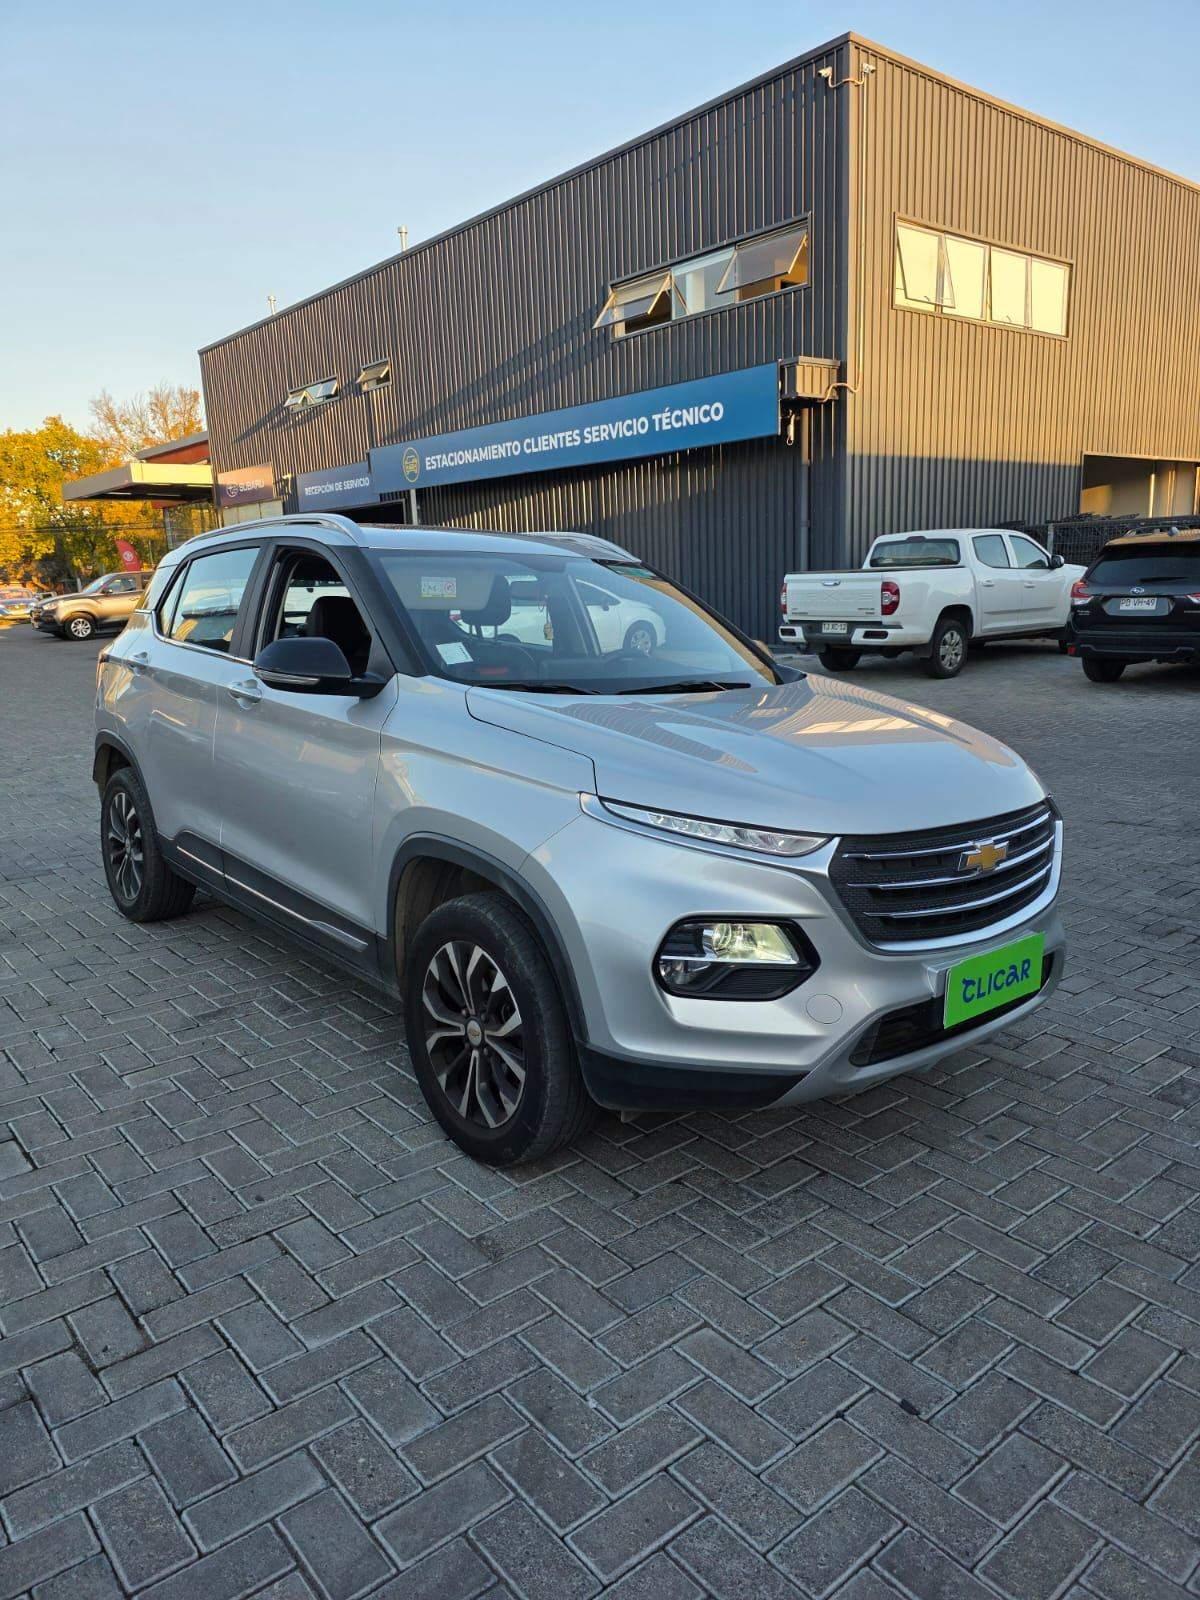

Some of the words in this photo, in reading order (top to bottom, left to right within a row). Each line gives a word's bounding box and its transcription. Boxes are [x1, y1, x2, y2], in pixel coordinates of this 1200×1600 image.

[425, 441, 521, 471] ESTACIONAMIENTO
[523, 430, 581, 454] CLIENTES
[583, 416, 649, 444] SERVICIO
[652, 402, 724, 431] TÉCNICO
[304, 481, 334, 496] RECEPCIÓN
[335, 482, 343, 491] DE
[343, 477, 369, 490] SERVICIO
